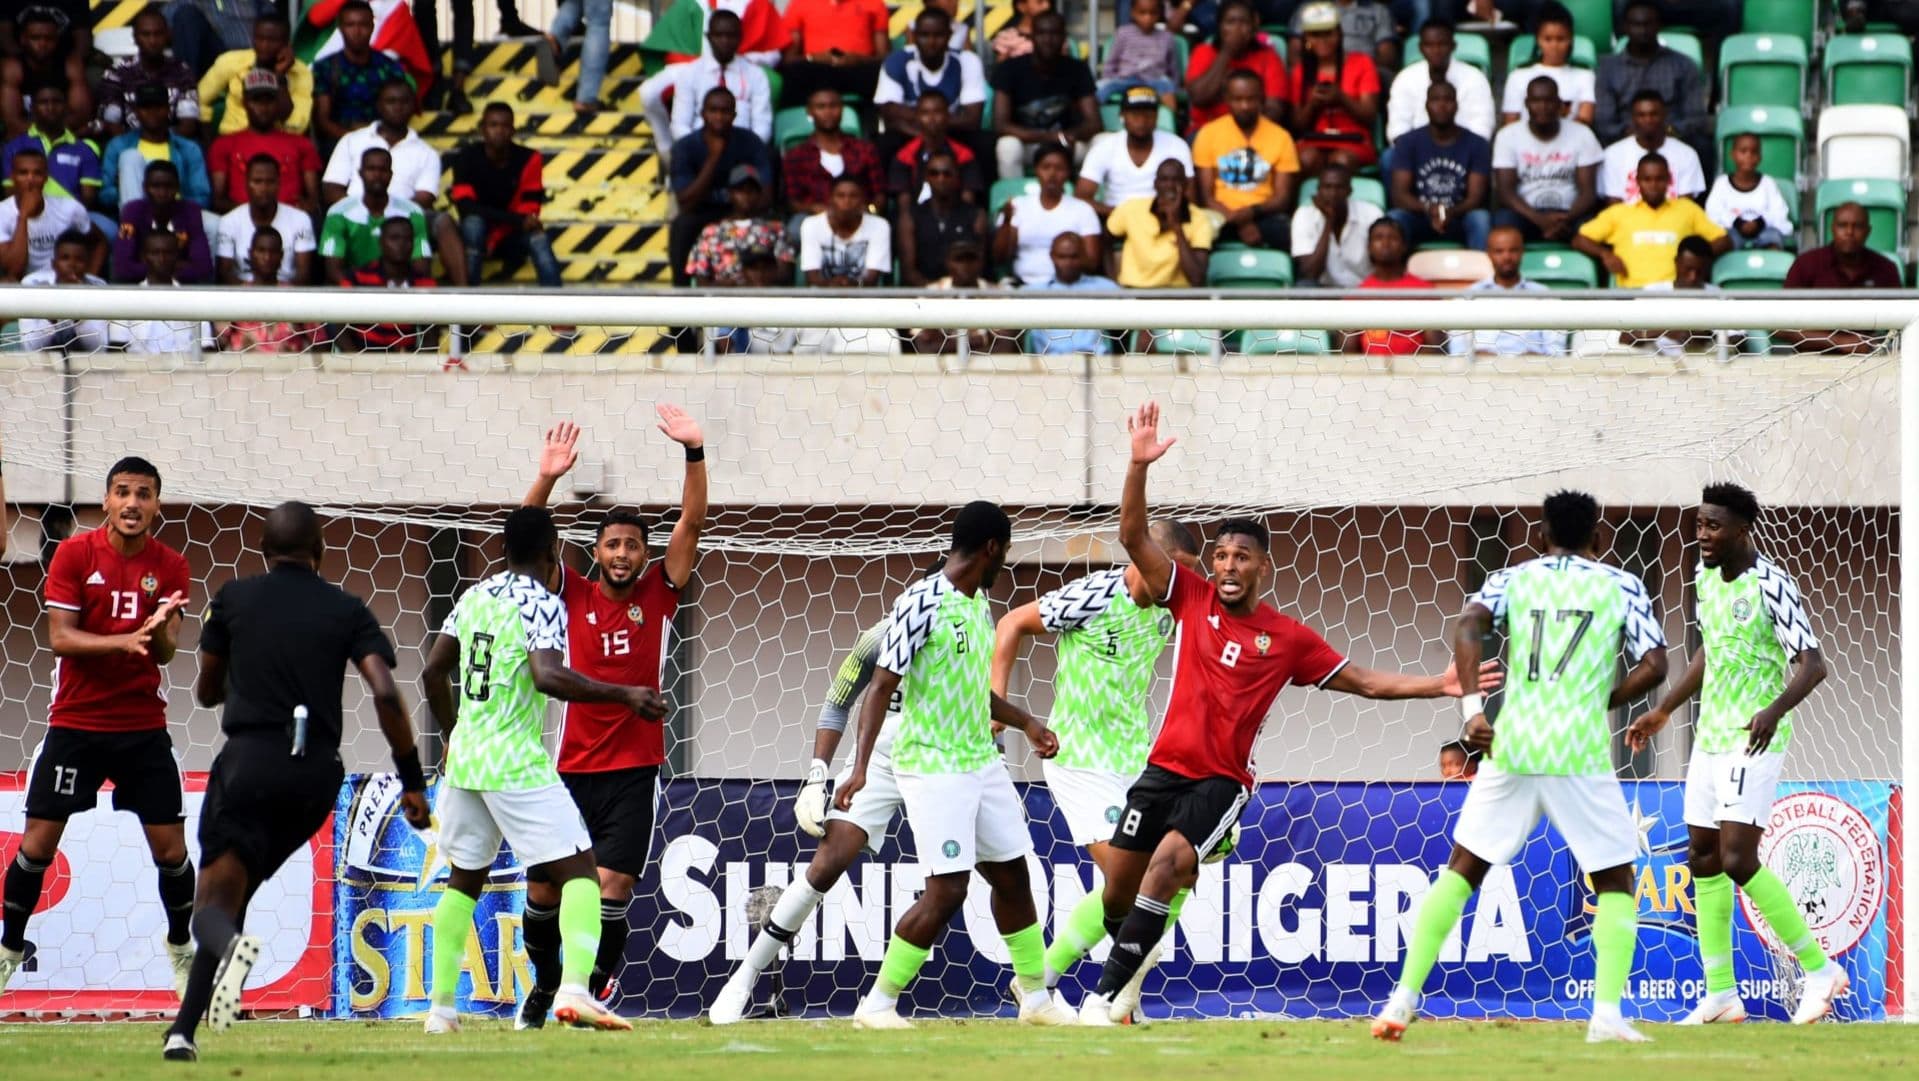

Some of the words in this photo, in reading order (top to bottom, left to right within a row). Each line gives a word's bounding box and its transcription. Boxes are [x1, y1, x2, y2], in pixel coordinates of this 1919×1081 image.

[111, 591, 138, 619] 13
[601, 629, 631, 656] 15
[956, 631, 969, 654] 21
[1107, 636, 1118, 656] 5
[1220, 640, 1241, 668] 8
[1527, 609, 1594, 681] 17
[465, 631, 494, 701] 8
[54, 765, 78, 795] 13
[1730, 767, 1746, 796] 4
[1122, 808, 1142, 837] 8
[1839, 815, 1876, 930] FEDERATION
[657, 834, 935, 962] SHINE
[1157, 862, 1533, 964] NIGERA
[1639, 978, 1677, 999] BEER
[1681, 978, 1706, 999] OF
